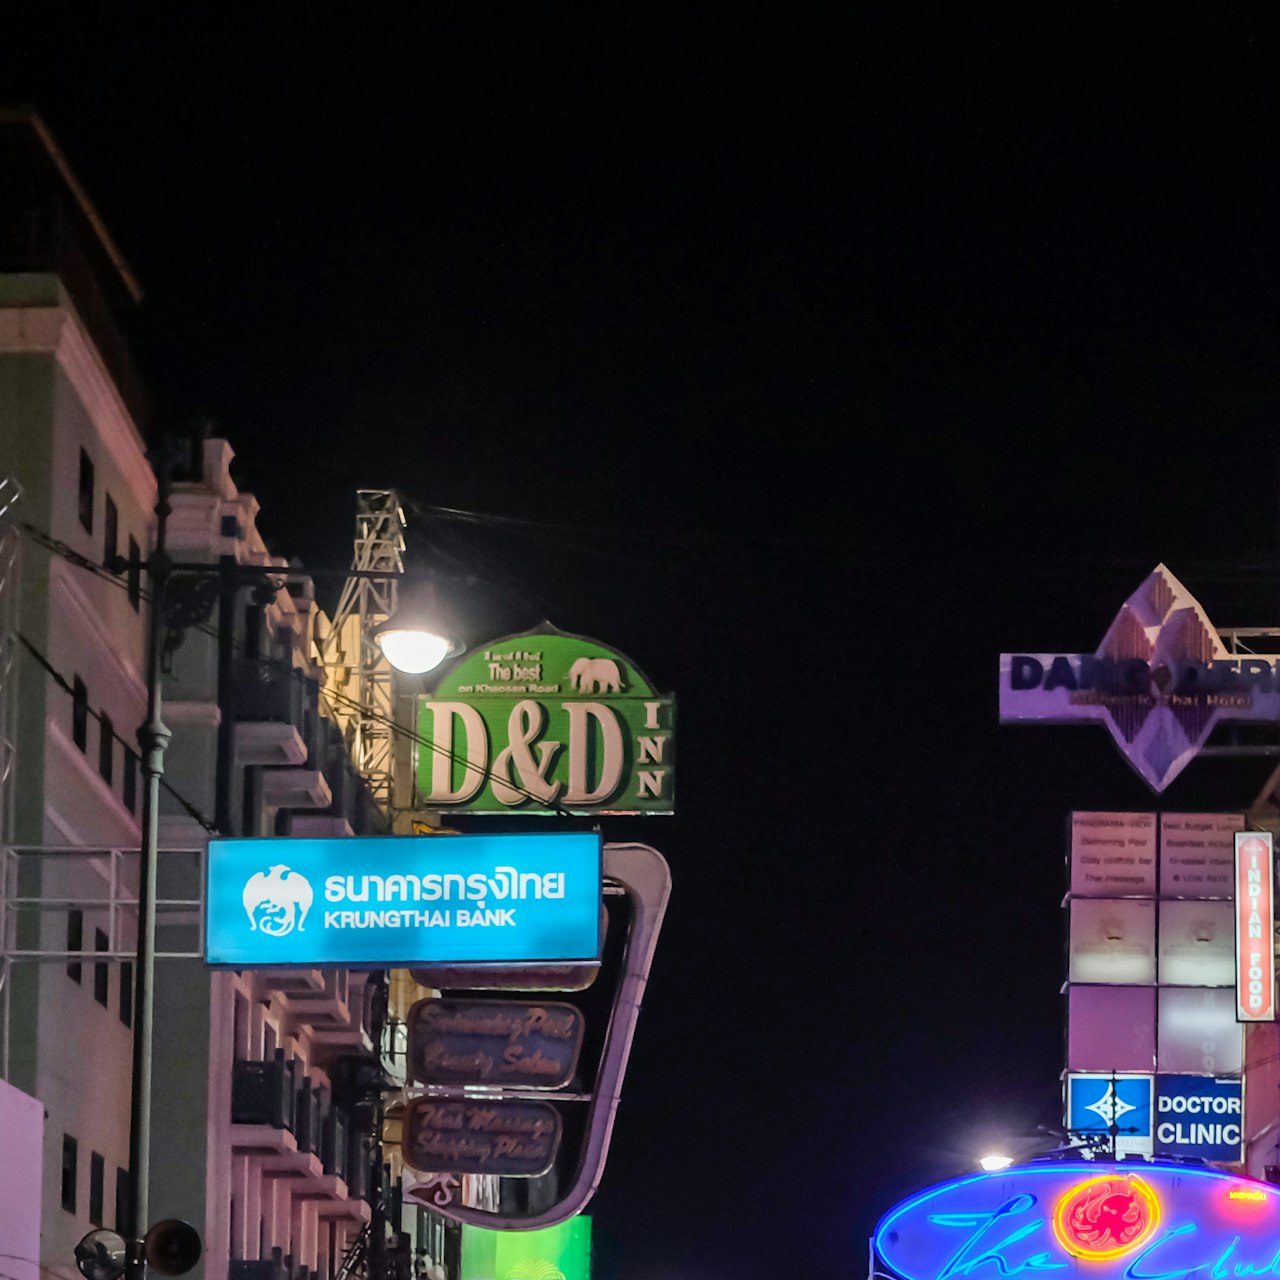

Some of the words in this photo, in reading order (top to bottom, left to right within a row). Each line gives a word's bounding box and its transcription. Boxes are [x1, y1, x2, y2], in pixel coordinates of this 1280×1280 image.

[489, 663, 511, 681] The
[513, 663, 543, 681] best
[422, 699, 624, 806] D&D
[636, 701, 667, 798] INN
[324, 866, 566, 910] ธนาคารกรุงไทย
[1247, 856, 1263, 939] INDIAN
[323, 909, 450, 930] KRUNGTHAI
[460, 908, 517, 928] BANK
[1249, 952, 1263, 1009] FOOD
[1158, 1096, 1242, 1115] DOCTOR
[1157, 1122, 1241, 1146] CLINIC
